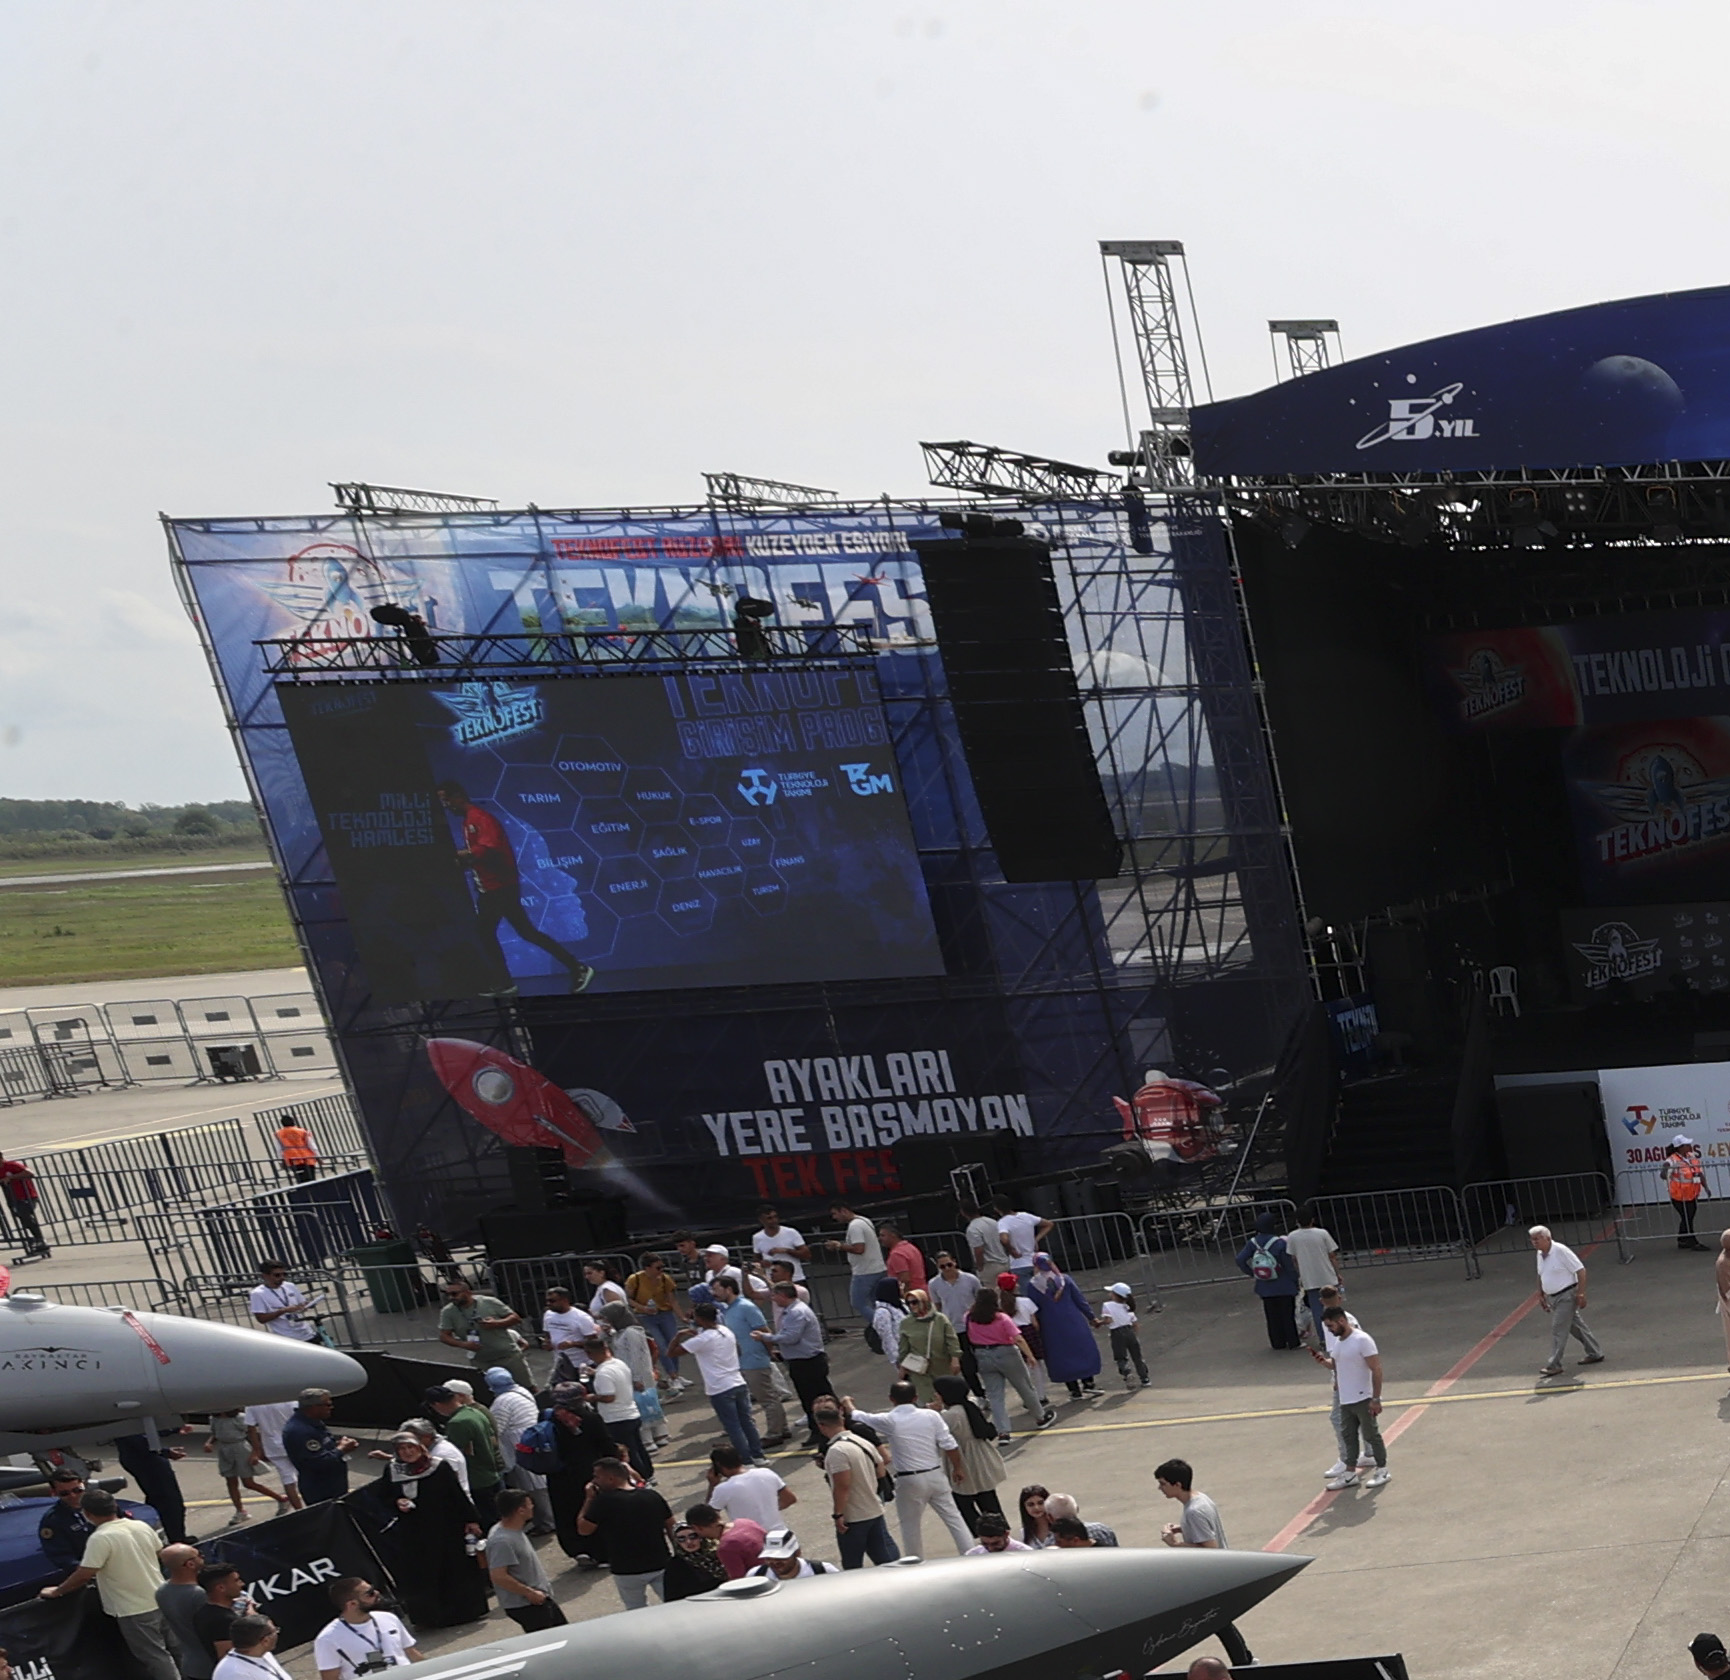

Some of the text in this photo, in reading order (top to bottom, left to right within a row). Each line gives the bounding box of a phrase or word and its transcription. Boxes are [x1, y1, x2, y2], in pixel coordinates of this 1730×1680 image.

[1572, 642, 1713, 697] TEKNOLOJİ
[1460, 674, 1527, 719] TEKNOFEST
[454, 698, 544, 743] TEKNOFEST
[798, 706, 891, 751] PROG
[558, 761, 623, 773] OTOMOTİV
[519, 792, 561, 804] TARIM
[636, 790, 673, 801] HUKUK
[327, 809, 433, 832] TEKNOLOJİ
[590, 821, 632, 835] EĞİTİM
[350, 826, 436, 849] HAMLESİ
[536, 854, 585, 870] BİLİŞİM
[651, 845, 689, 860] SAĞLIK
[608, 879, 650, 895] ENERJİ
[1580, 947, 1665, 991] TEKNOFEST
[763, 1049, 957, 1104] AYAKLARI
[702, 1093, 1035, 1157] YERE BASMAYAN
[1626, 1148, 1644, 1164] 30
[742, 1153, 826, 1201] TEK
[246, 1557, 342, 1608] YKAR
